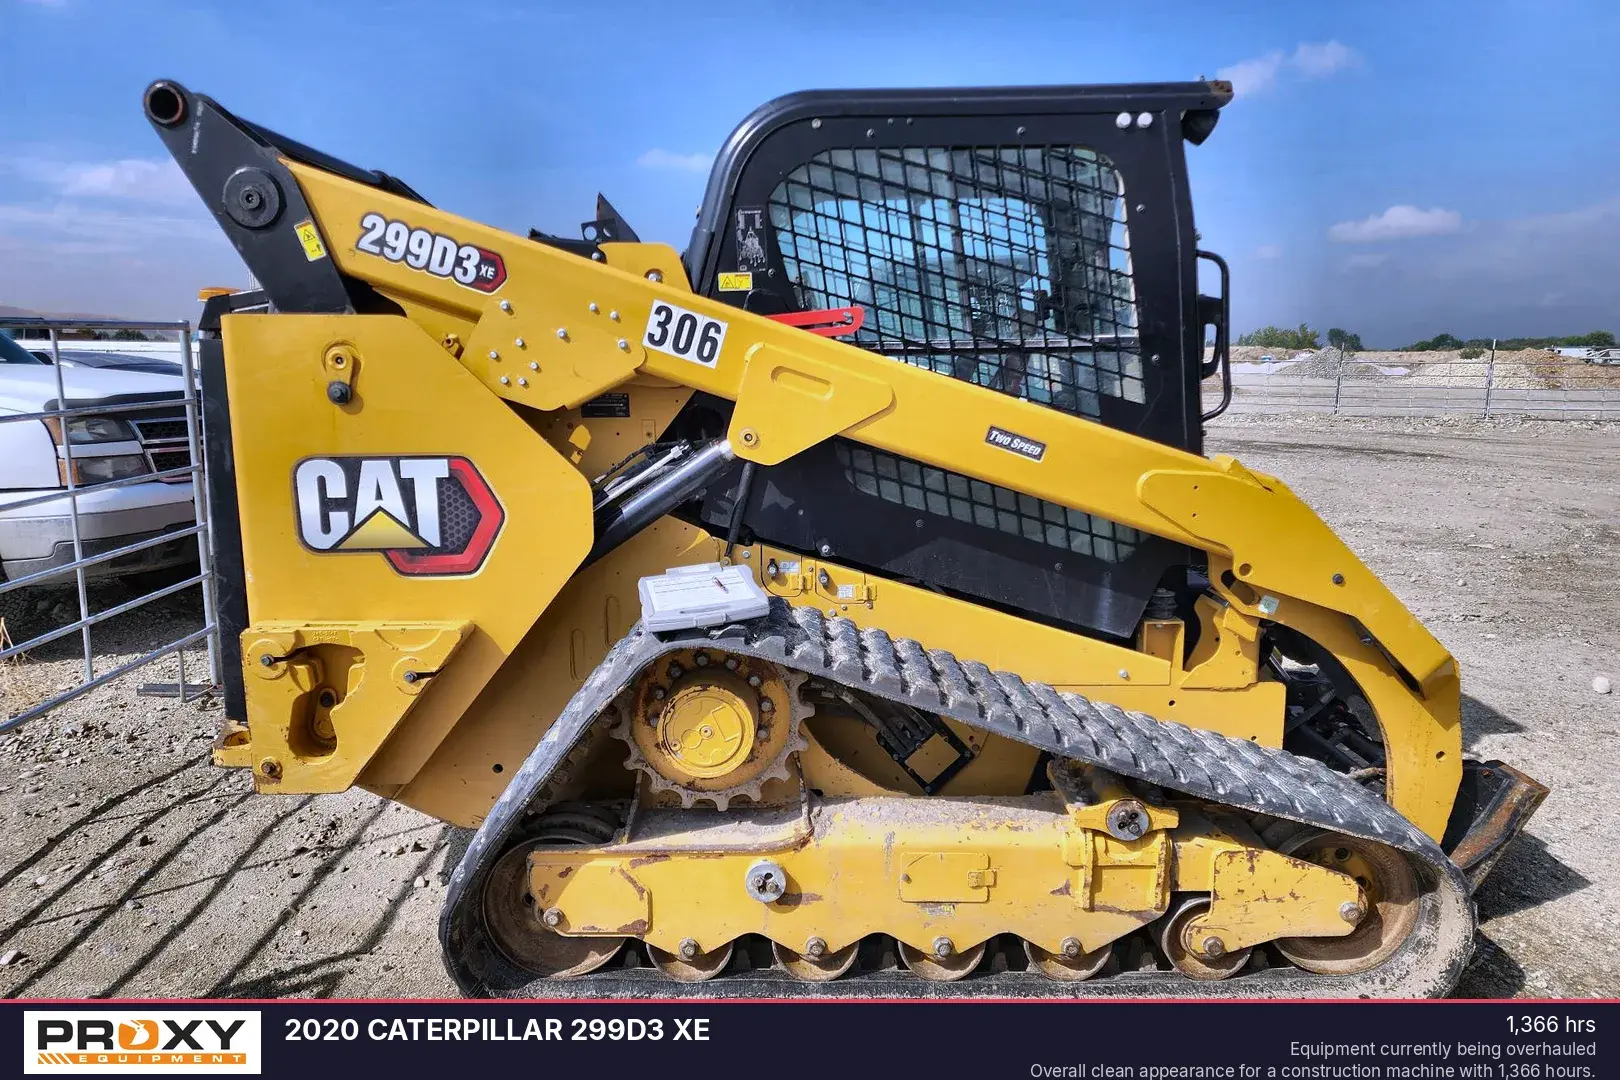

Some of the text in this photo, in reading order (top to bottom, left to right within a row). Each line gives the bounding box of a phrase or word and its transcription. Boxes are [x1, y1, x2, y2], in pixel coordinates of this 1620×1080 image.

[358, 214, 495, 284] 299D3 XE
[648, 305, 721, 363] 306
[297, 459, 448, 549] CAT
